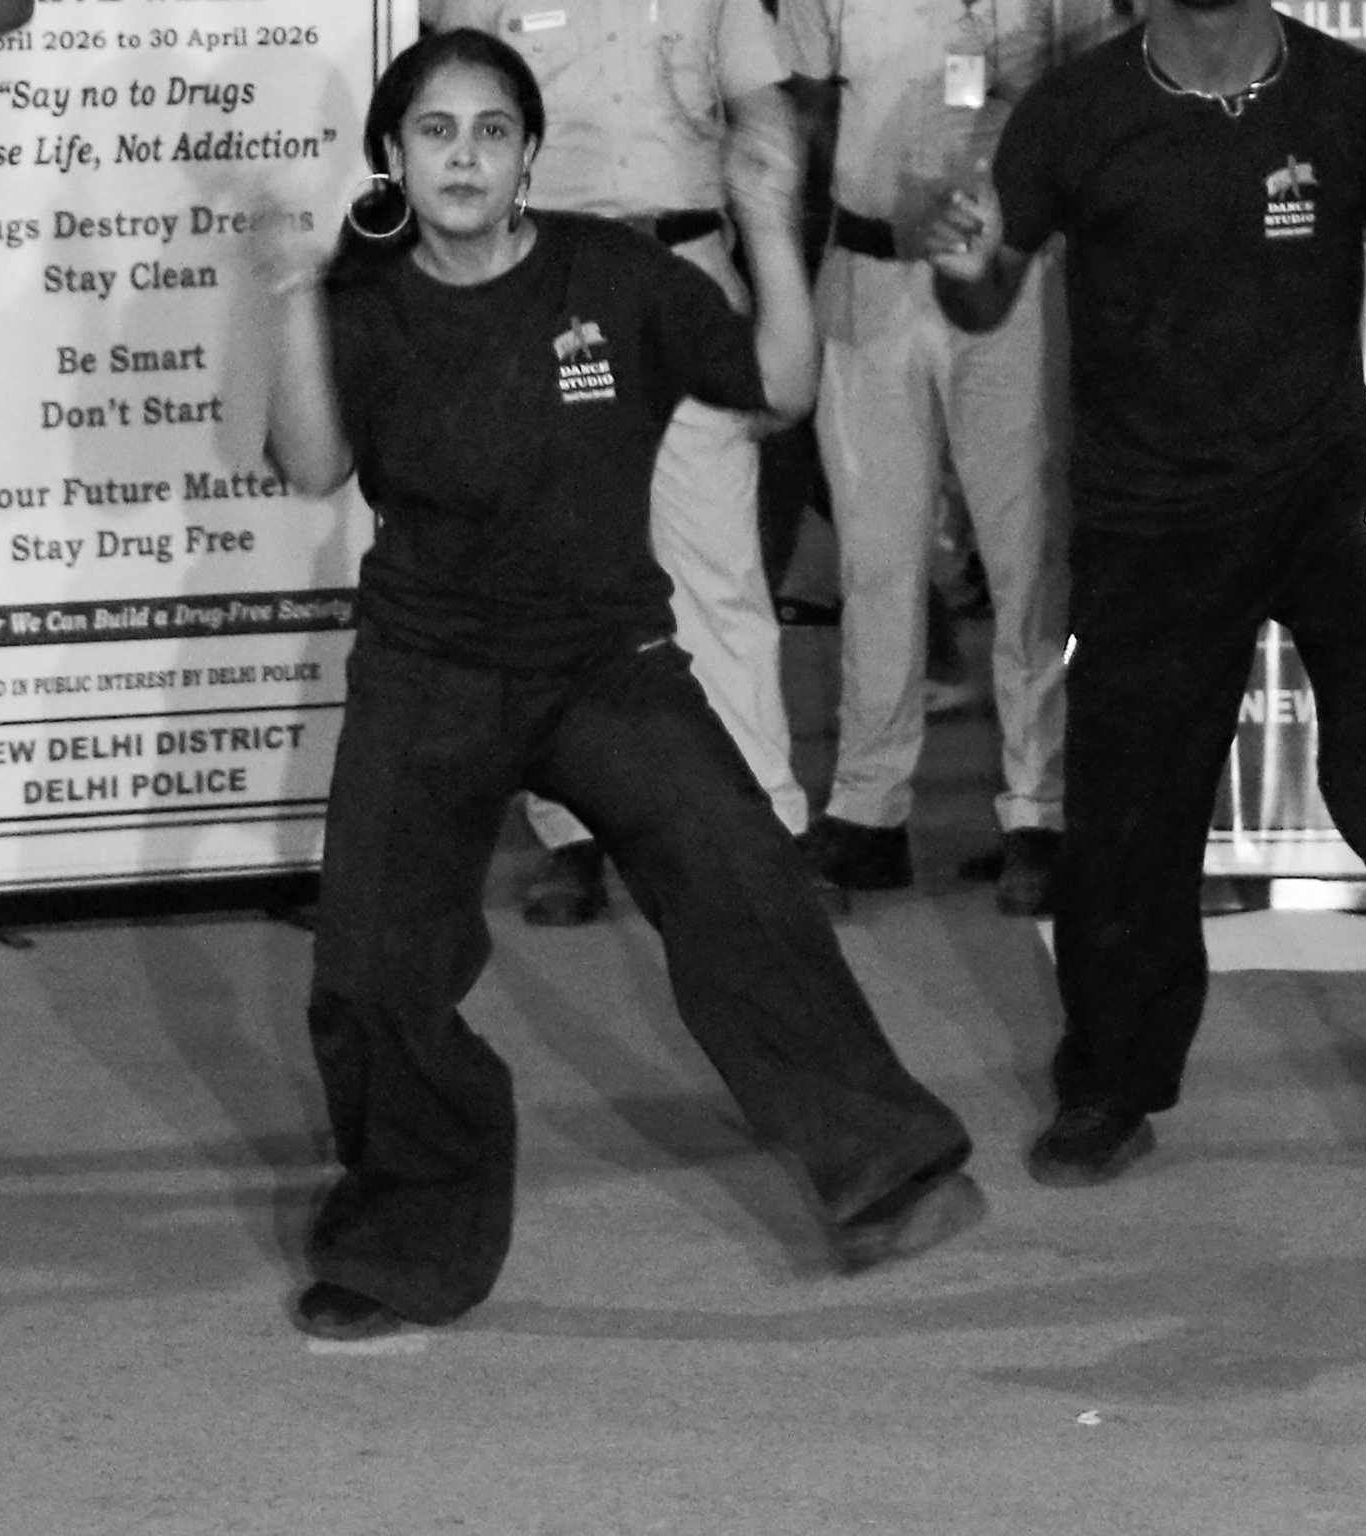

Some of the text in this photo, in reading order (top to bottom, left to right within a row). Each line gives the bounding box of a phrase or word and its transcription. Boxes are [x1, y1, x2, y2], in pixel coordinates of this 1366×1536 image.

[42, 30, 107, 51] 2026
[118, 28, 142, 50] to
[149, 27, 179, 48] 30
[186, 25, 248, 52] April
[256, 25, 319, 46] 2026
[81, 85, 118, 109] no
[130, 79, 156, 107] to
[167, 76, 256, 113] Drugs
[35, 134, 101, 173] Life,
[115, 132, 163, 164] Not
[54, 209, 179, 244] Destroy
[44, 260, 219, 299] Stay Clean
[57, 344, 206, 375] Be Smart
[41, 395, 223, 429] Don't Start
[63, 477, 172, 507] Future
[11, 524, 255, 568] Stay Drug Free
[10, 610, 42, 635] We
[46, 609, 88, 633] Can
[94, 606, 151, 631] Build
[154, 609, 169, 628] a
[11, 677, 29, 696] IN
[35, 675, 92, 695] PUBLIC
[97, 670, 177, 692] INTEREST
[182, 668, 204, 688] BY
[207, 665, 257, 686] DELHI
[262, 663, 321, 683] POLICE
[47, 733, 143, 763] DELHI
[156, 723, 306, 756] DISTRICT
[23, 767, 248, 805] DELHI POLICE
